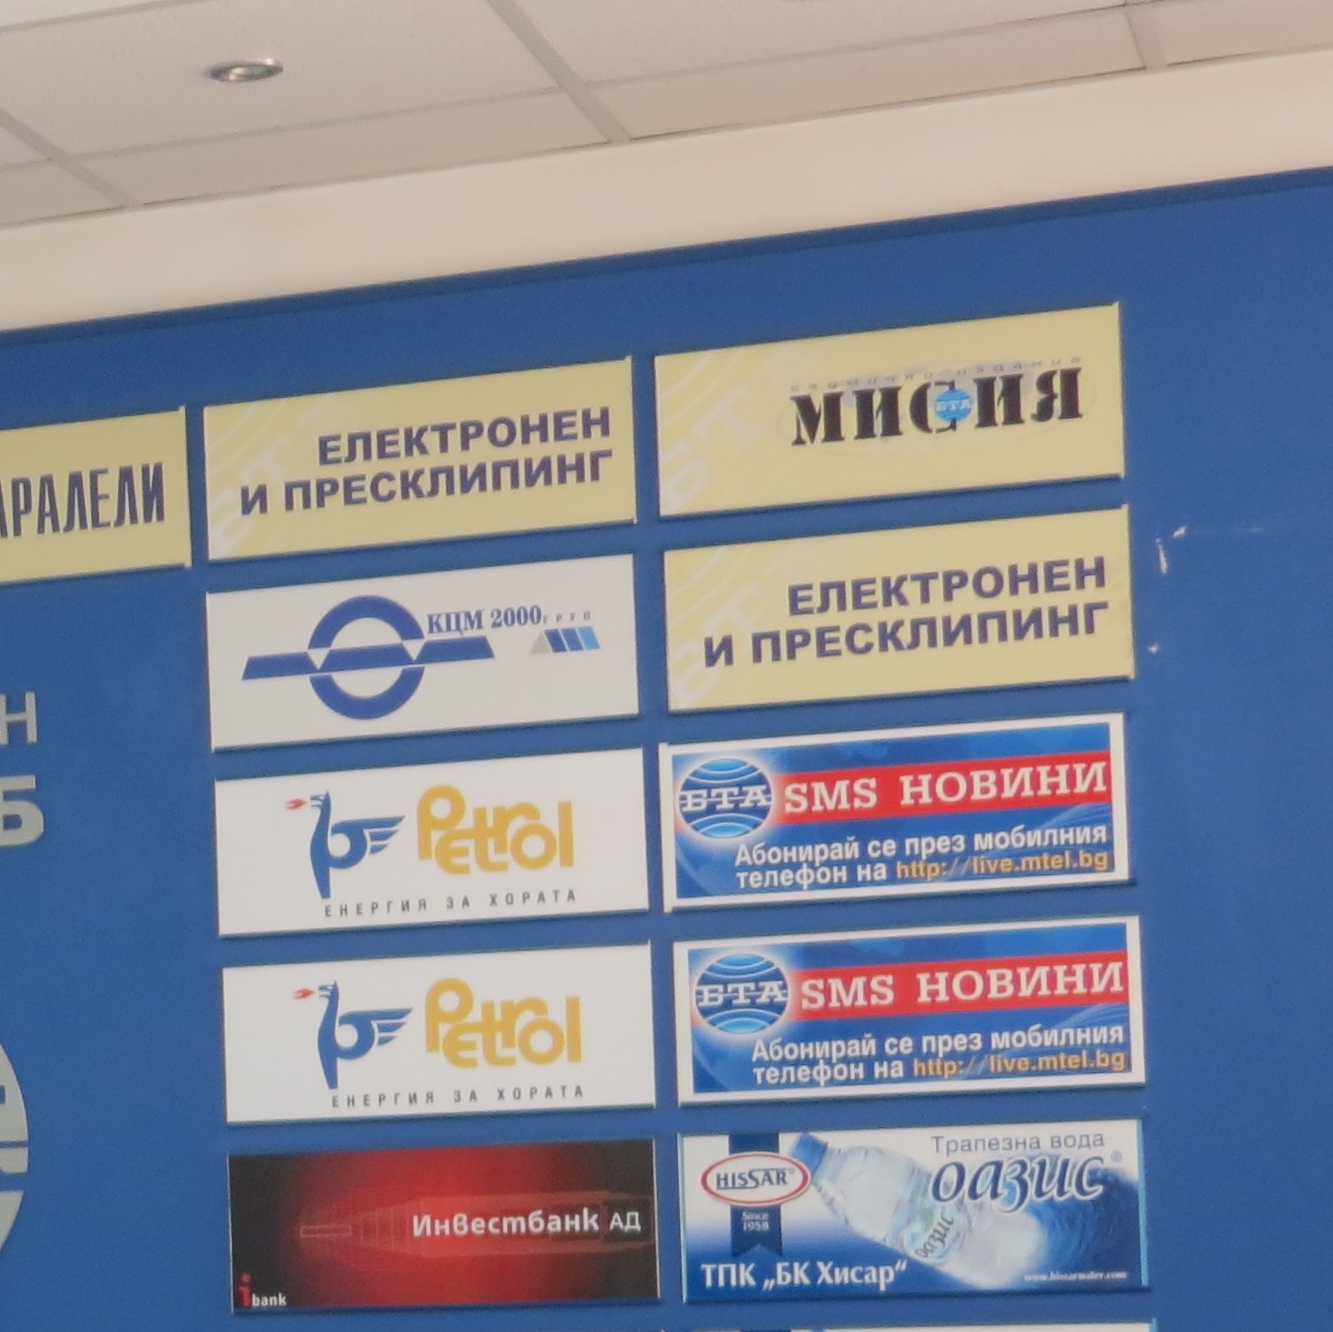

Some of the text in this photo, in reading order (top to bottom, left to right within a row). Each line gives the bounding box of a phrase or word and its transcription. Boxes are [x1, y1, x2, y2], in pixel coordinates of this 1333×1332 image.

[790, 366, 1083, 446] МИСИЯ
[318, 406, 611, 466] ЕЛЕКТРОНЕН
[240, 449, 613, 516] И ПРЕСКЛИПИНГ
[788, 556, 1106, 616] ЕЛЕКТРОНЕН
[427, 610, 483, 637] КЦМ
[490, 605, 542, 630] 2000
[704, 601, 1109, 668] И ПРЕСКЛИПИНГ
[680, 784, 773, 812] БТА
[783, 761, 1108, 814] SMS НОВИНИ
[417, 784, 575, 875] Petrol
[735, 824, 1107, 867] Абонирай се през мобилния
[735, 865, 847, 891] телефон
[857, 862, 886, 880] на
[324, 889, 576, 918] ЕНЕРГИЯ ЗА ХОРАТА
[695, 980, 788, 1008] БТА
[801, 961, 1124, 1010] SMS НОВИНИ
[424, 977, 583, 1069] Petrol
[752, 1022, 1124, 1063] Абонирай се през мобилния
[752, 1060, 864, 1086] телефон
[874, 1059, 904, 1078] на
[332, 1085, 585, 1108] ЕНЕРГИЯ ЗА ХОРАТА
[932, 1132, 1105, 1157] Трапезна вода
[716, 1168, 789, 1190] HISSAR
[932, 1154, 1106, 1213] оазис
[412, 1207, 641, 1237] Инвестбанк АД
[701, 1263, 756, 1288] ТПК
